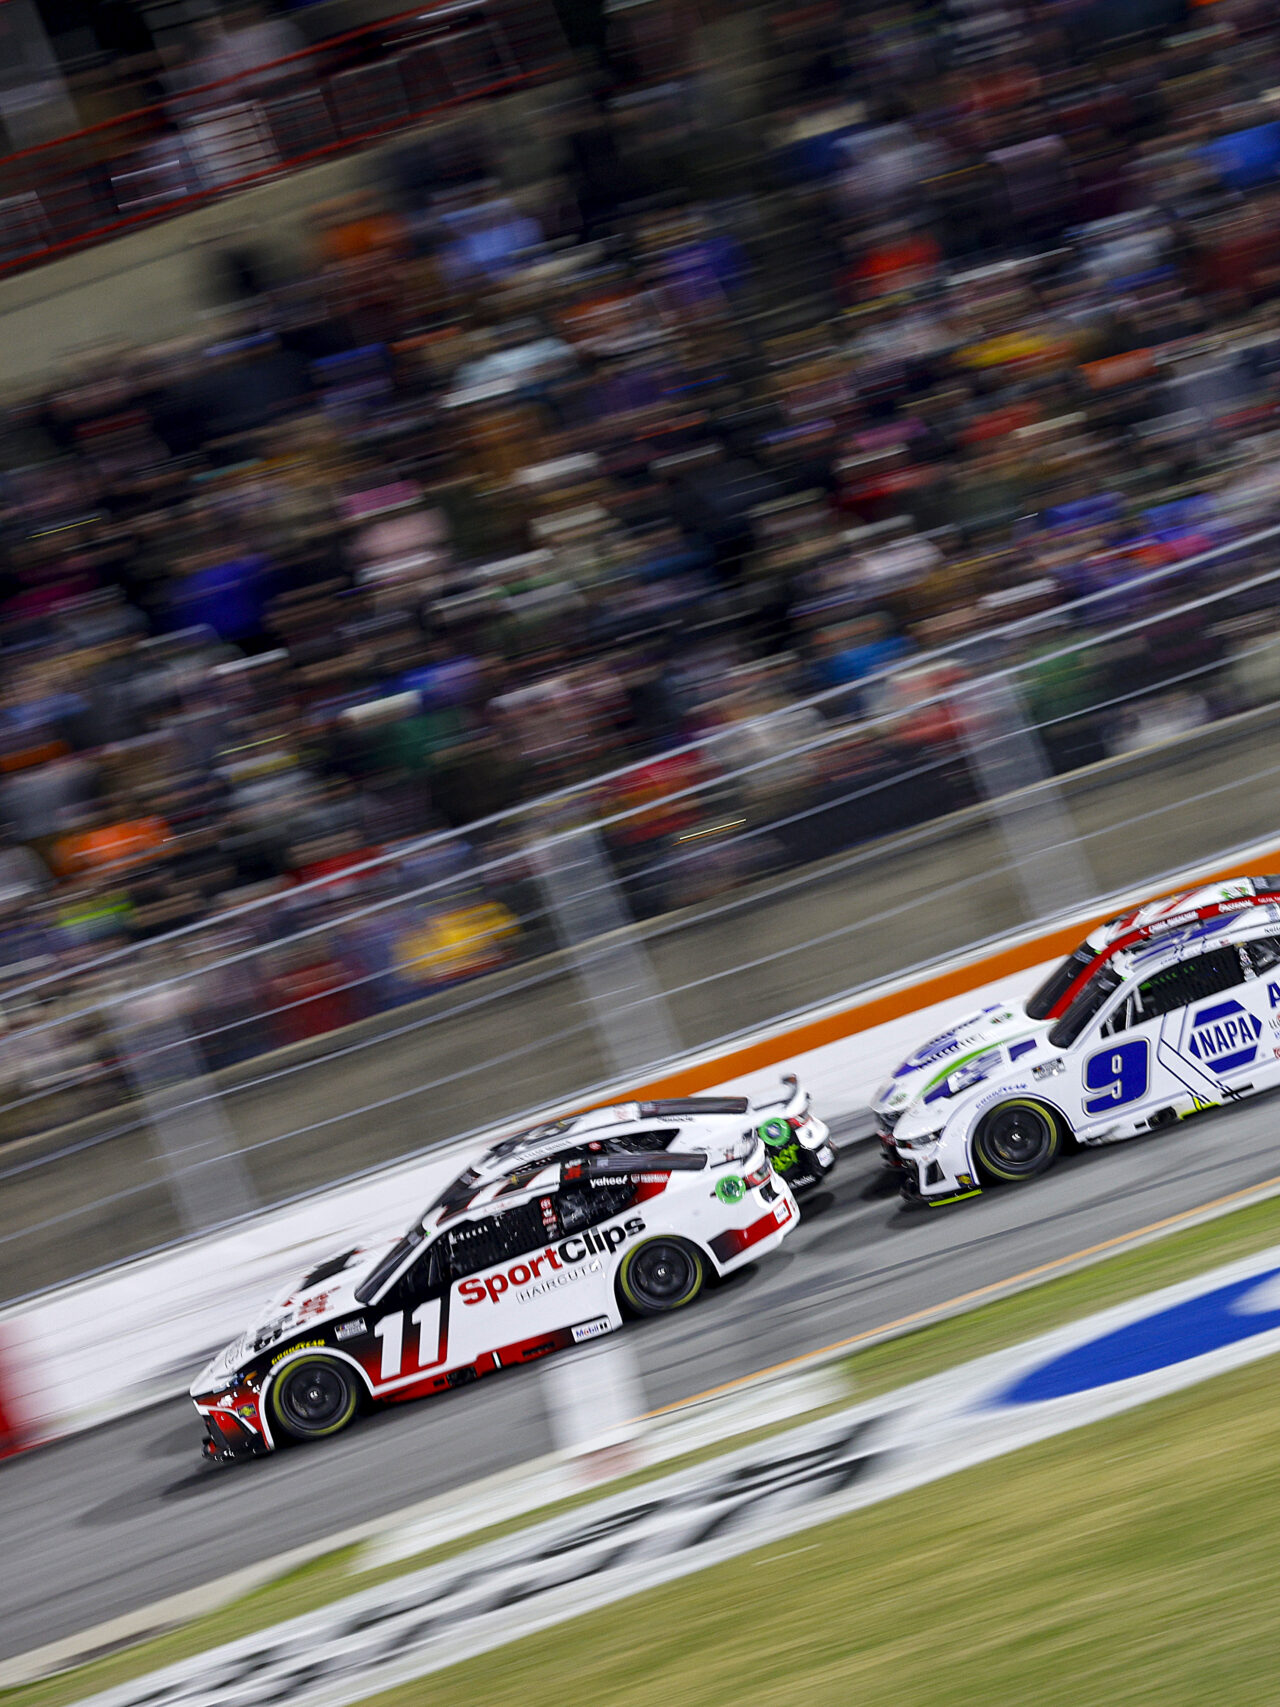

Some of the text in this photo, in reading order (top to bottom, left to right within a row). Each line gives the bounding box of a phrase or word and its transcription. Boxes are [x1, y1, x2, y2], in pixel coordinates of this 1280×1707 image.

[1197, 1016, 1255, 1058] NAPA
[1084, 1038, 1150, 1115] 9
[374, 1296, 441, 1380] 11
